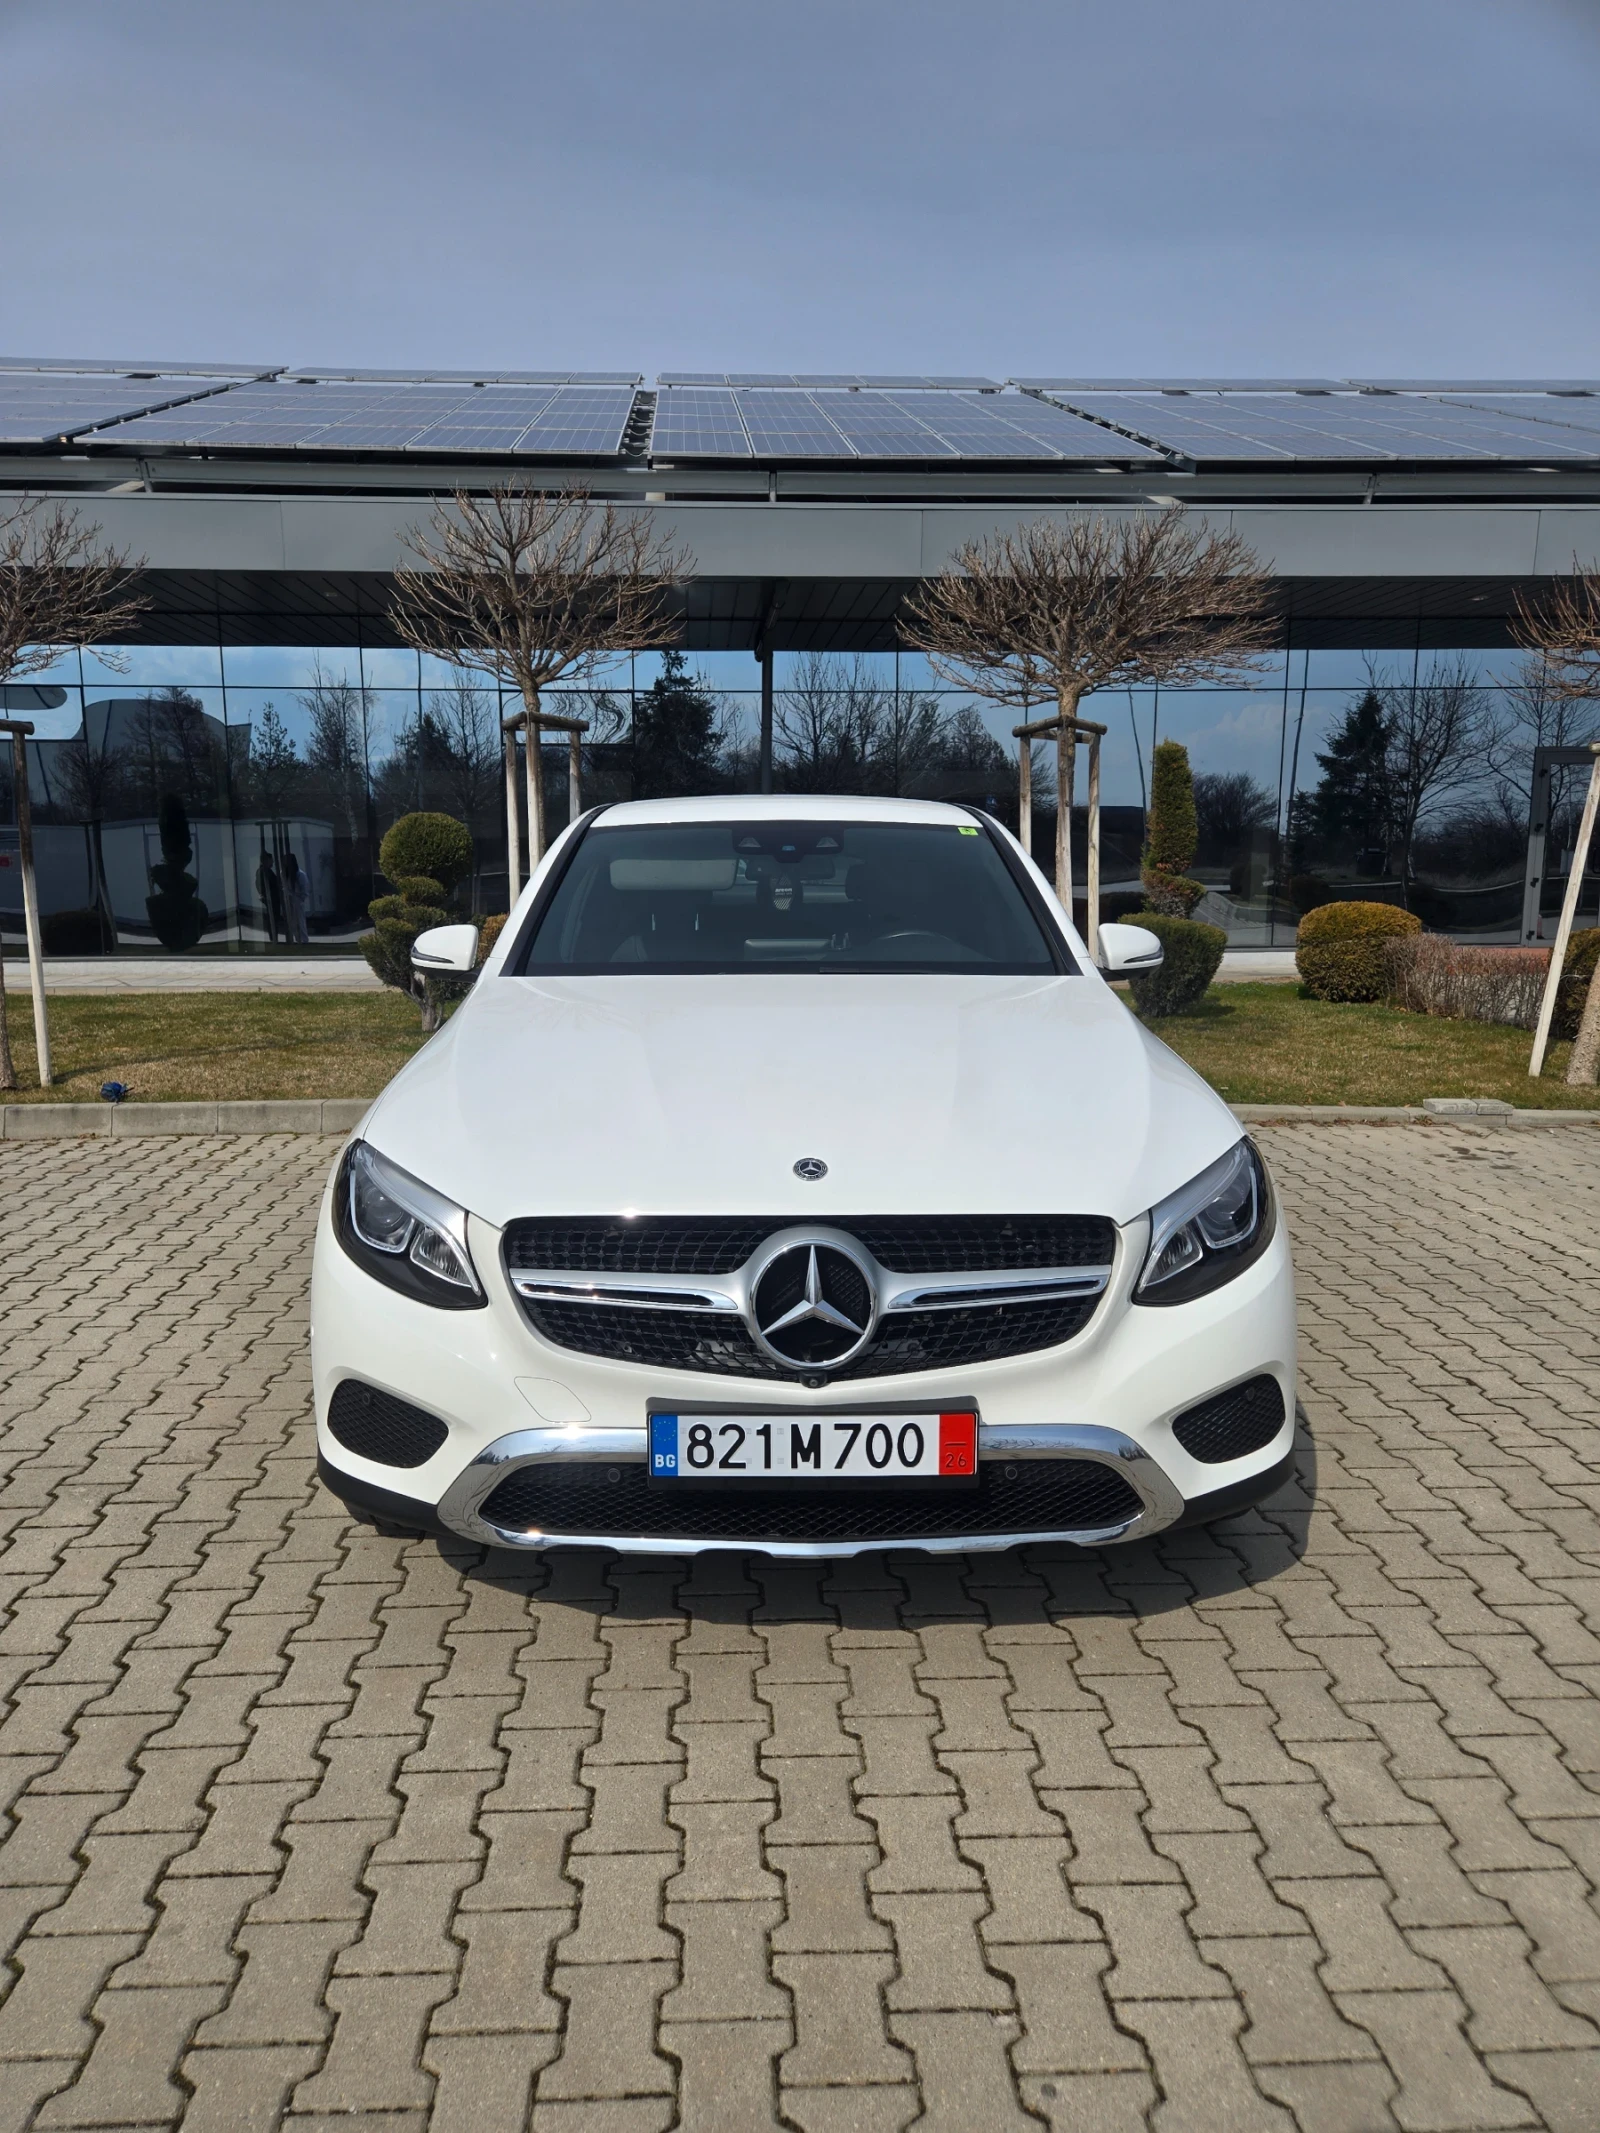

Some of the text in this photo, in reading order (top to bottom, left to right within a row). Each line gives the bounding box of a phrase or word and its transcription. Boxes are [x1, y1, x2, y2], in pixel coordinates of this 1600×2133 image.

[686, 1422, 925, 1469] 821 M 700
[655, 1454, 676, 1468] BG
[945, 1452, 967, 1468] 26
